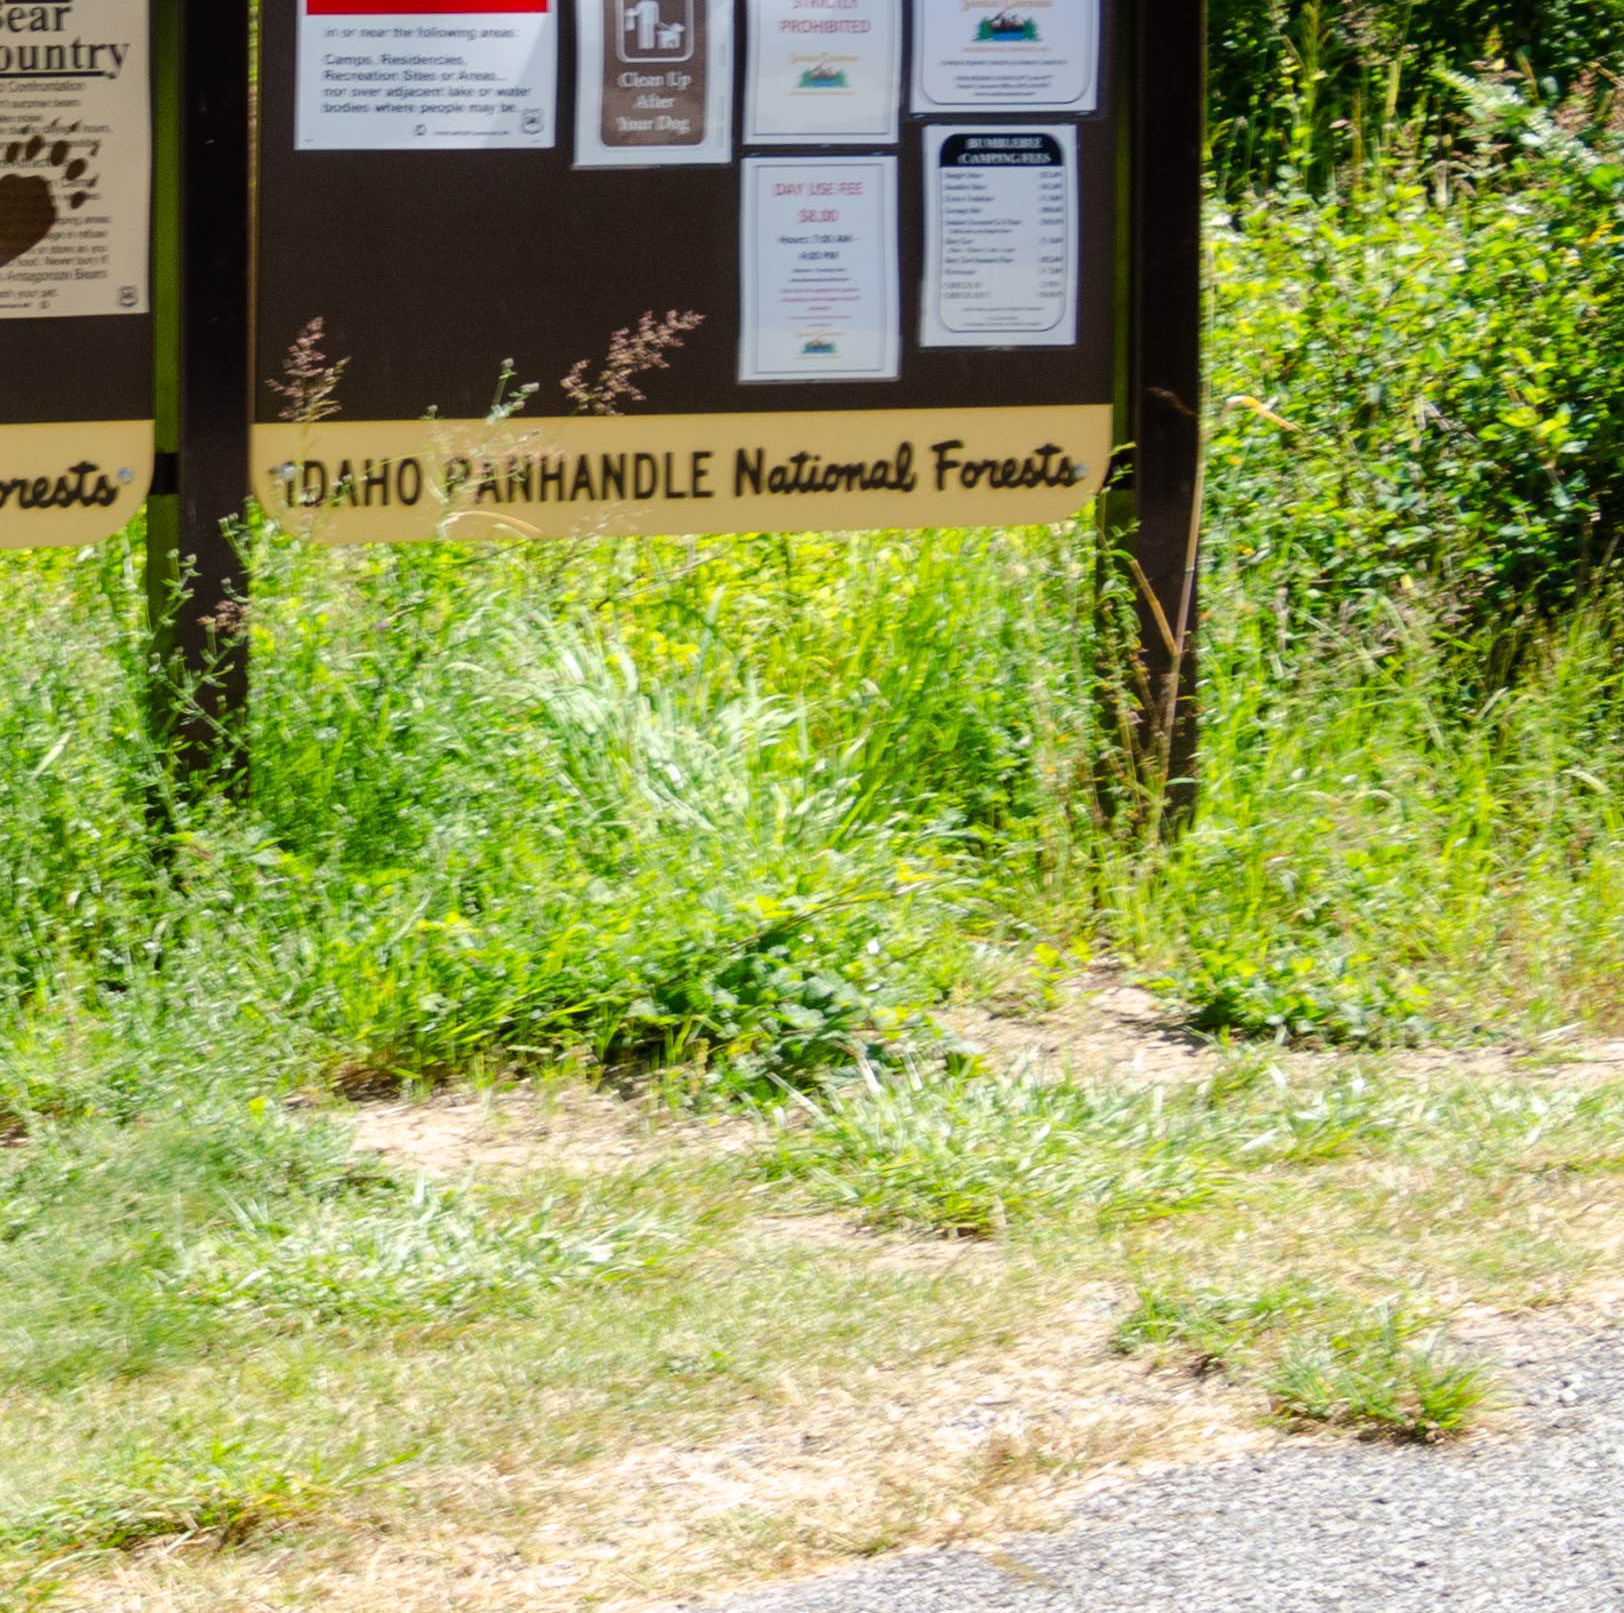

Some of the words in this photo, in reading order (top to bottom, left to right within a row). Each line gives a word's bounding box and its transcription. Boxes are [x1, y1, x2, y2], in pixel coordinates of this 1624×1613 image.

[360, 28, 390, 37] near
[417, 26, 477, 41] following
[778, 19, 872, 34] PROHIBITED
[323, 69, 399, 82] Recreation
[402, 69, 437, 81] Sites
[441, 71, 455, 81] or
[617, 72, 664, 87] Clean
[666, 72, 693, 90] Up
[350, 87, 382, 97] over
[385, 85, 445, 100] adjacent
[479, 87, 493, 97] or
[495, 86, 533, 97] water
[322, 102, 370, 114] bodies
[374, 102, 417, 113] where
[420, 103, 466, 116] people
[468, 103, 496, 117] may
[633, 94, 676, 110] After
[615, 116, 652, 131] Your
[654, 115, 692, 135] Dog
[965, 137, 1043, 149] BUMBLEBEE
[774, 183, 804, 196] DAY
[444, 450, 714, 506] PANHANDLE
[733, 440, 918, 498] National
[930, 439, 1078, 491] Forests
